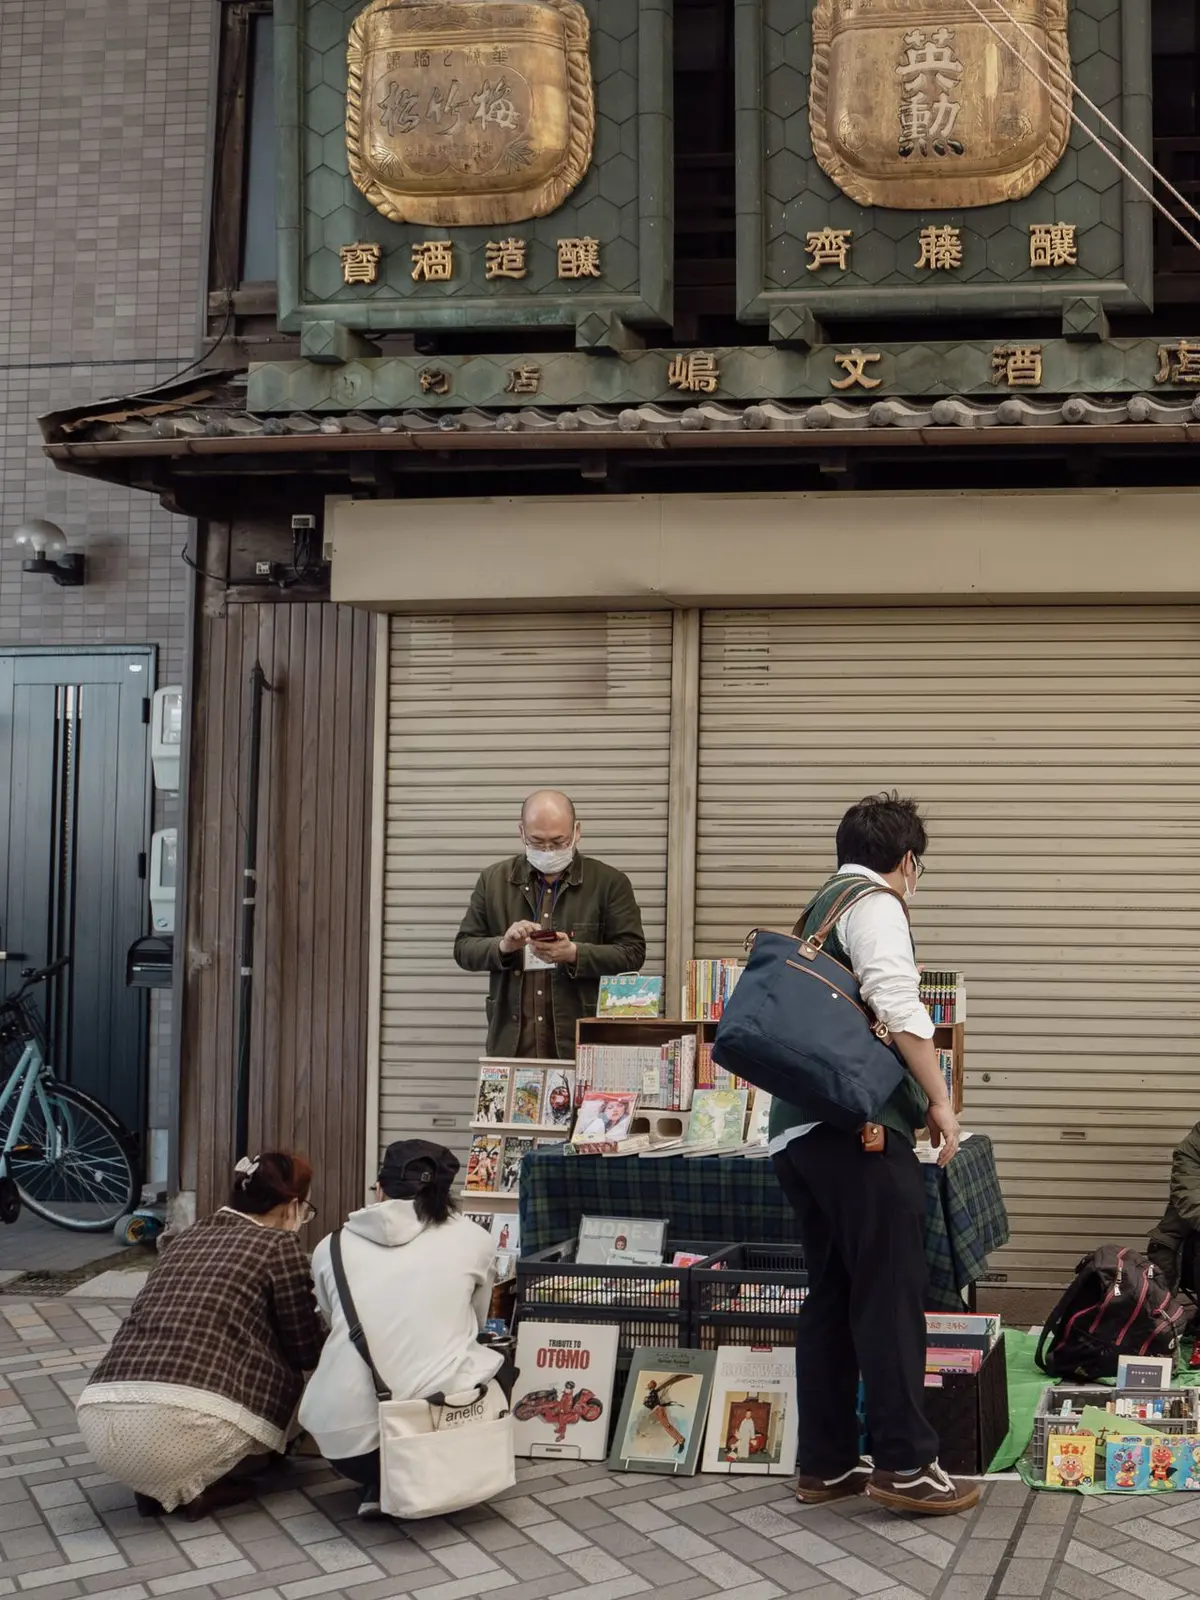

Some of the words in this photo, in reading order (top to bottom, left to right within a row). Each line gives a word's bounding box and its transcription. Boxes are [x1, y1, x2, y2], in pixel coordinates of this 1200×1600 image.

[549, 1339, 572, 1348] TRIBUTE
[574, 1340, 581, 1348] TO
[536, 1348, 590, 1370] OTOMO
[445, 1403, 484, 1422] anello
